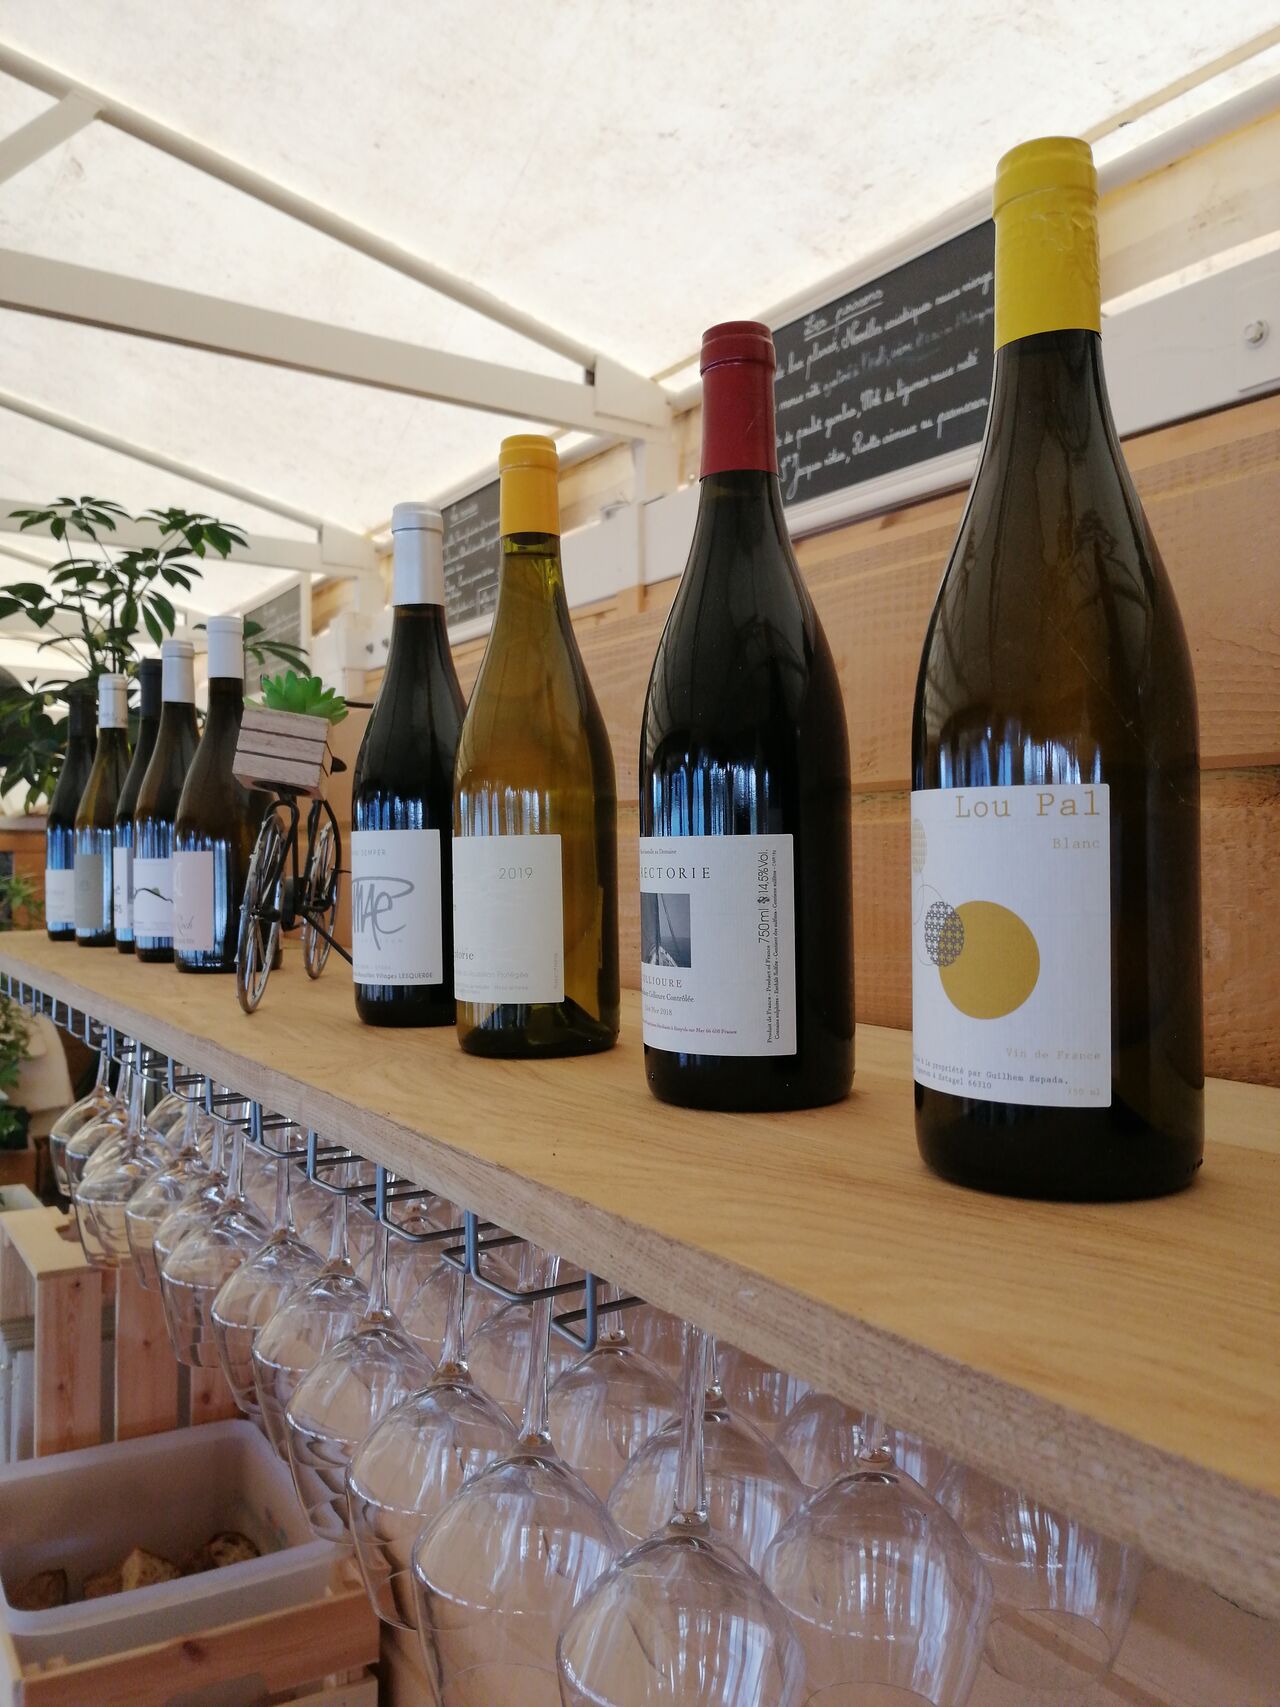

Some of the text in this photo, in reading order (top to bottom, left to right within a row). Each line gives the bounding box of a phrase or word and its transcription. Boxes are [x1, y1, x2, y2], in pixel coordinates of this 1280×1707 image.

[955, 789, 1101, 818] Lou Pal
[1052, 837, 1101, 850] Blanc
[498, 866, 533, 880] 2019
[1005, 1047, 1101, 1061] Vin de France
[968, 1069, 981, 1079] par
[986, 1071, 1024, 1082] Guilhem
